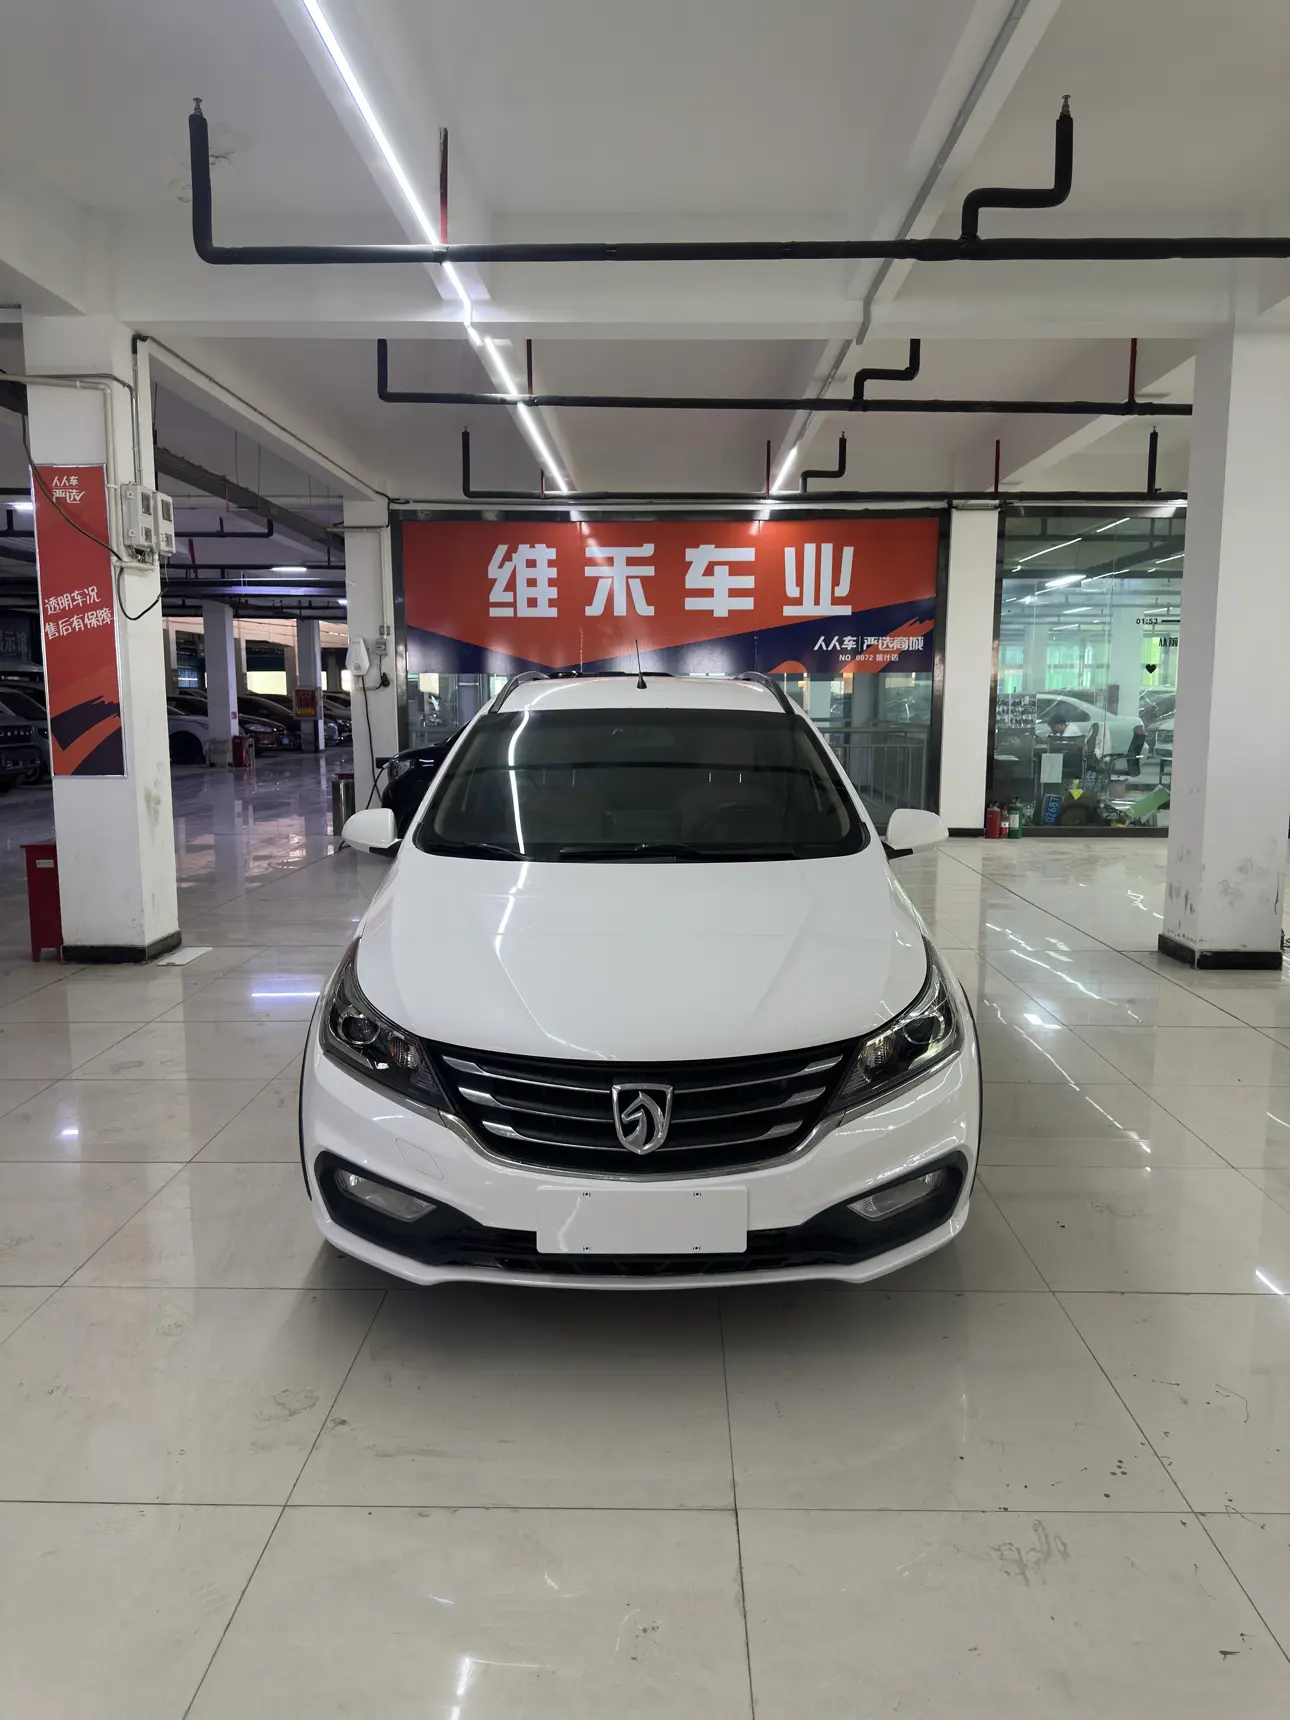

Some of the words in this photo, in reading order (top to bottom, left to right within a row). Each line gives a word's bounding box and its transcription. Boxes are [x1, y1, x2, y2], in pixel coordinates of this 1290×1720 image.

[52, 475, 79, 487] 人人车
[487, 542, 854, 618] 维禾车业
[45, 586, 101, 615] 透明车况
[45, 607, 113, 640] 售后有保障
[1135, 617, 1158, 625] 01:53
[813, 636, 857, 651] 人人车
[863, 636, 924, 651] 严选商城
